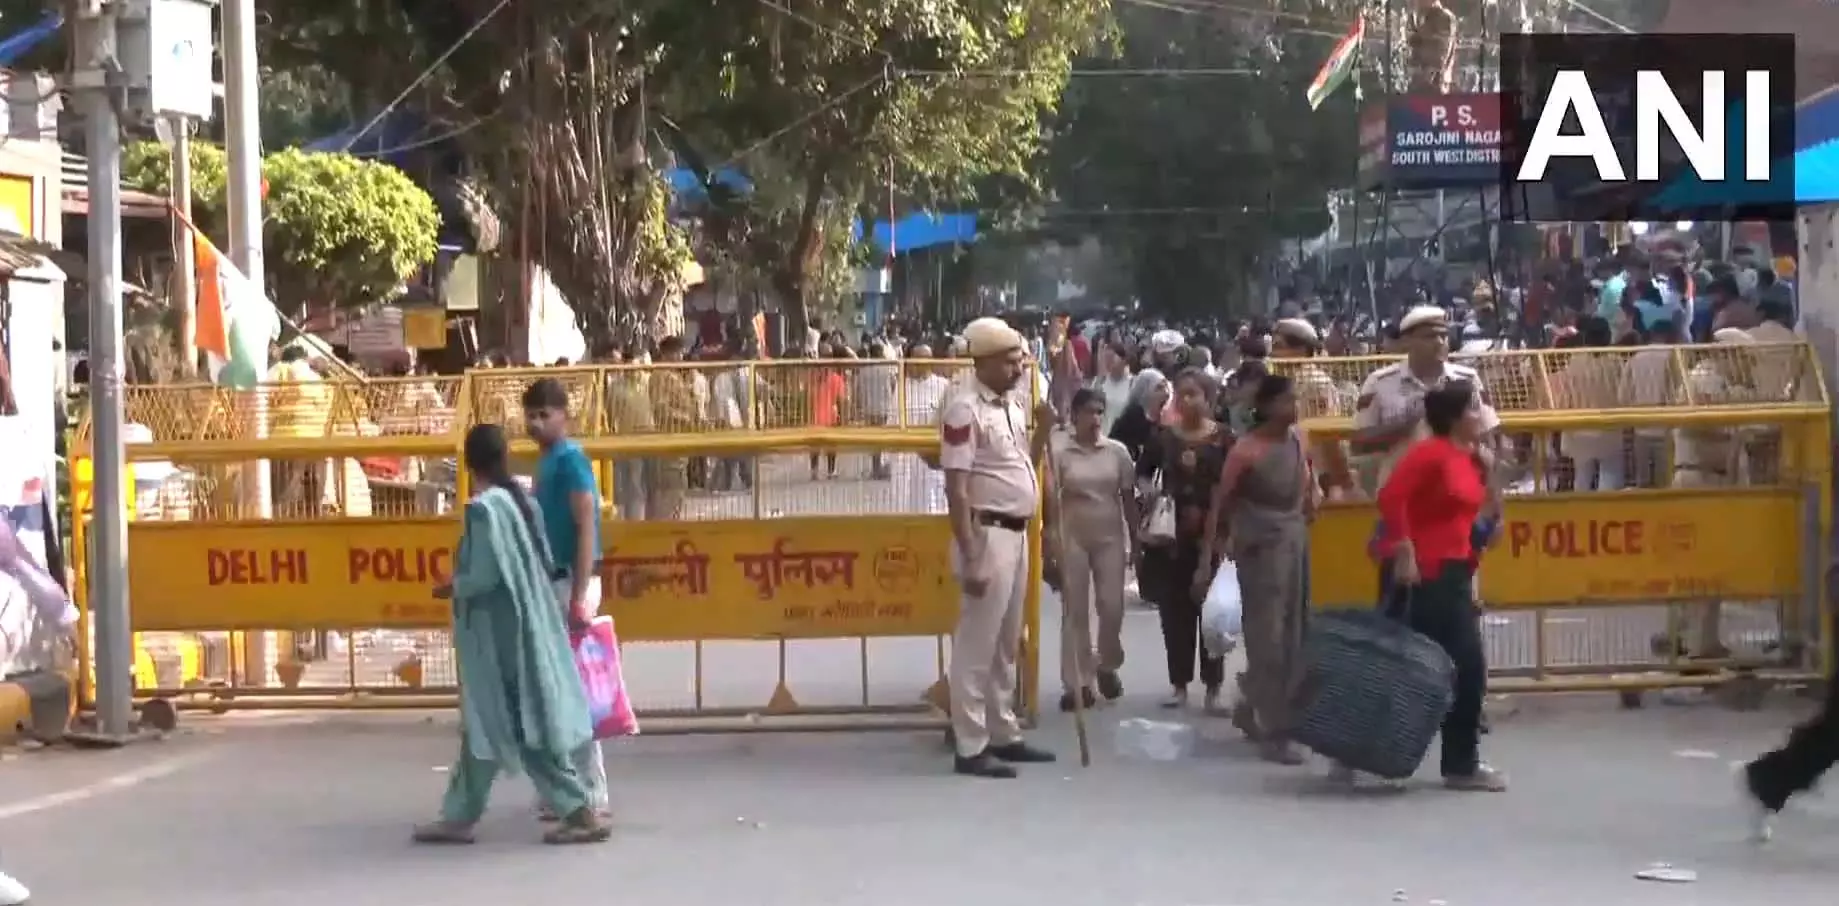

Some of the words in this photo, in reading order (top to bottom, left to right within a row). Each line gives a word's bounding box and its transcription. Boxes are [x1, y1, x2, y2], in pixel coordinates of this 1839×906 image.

[1431, 104, 1448, 127] P.
[1457, 104, 1477, 127] S.
[1396, 131, 1460, 146] SAROJINI
[1465, 129, 1509, 145] NAGA
[1391, 150, 1431, 165] SOUTH
[1434, 149, 1463, 163] WEST
[1510, 519, 1643, 559] POLICE
[207, 547, 309, 586] DELHI
[349, 547, 451, 585] POLIC
[734, 537, 859, 599] पुलिस
